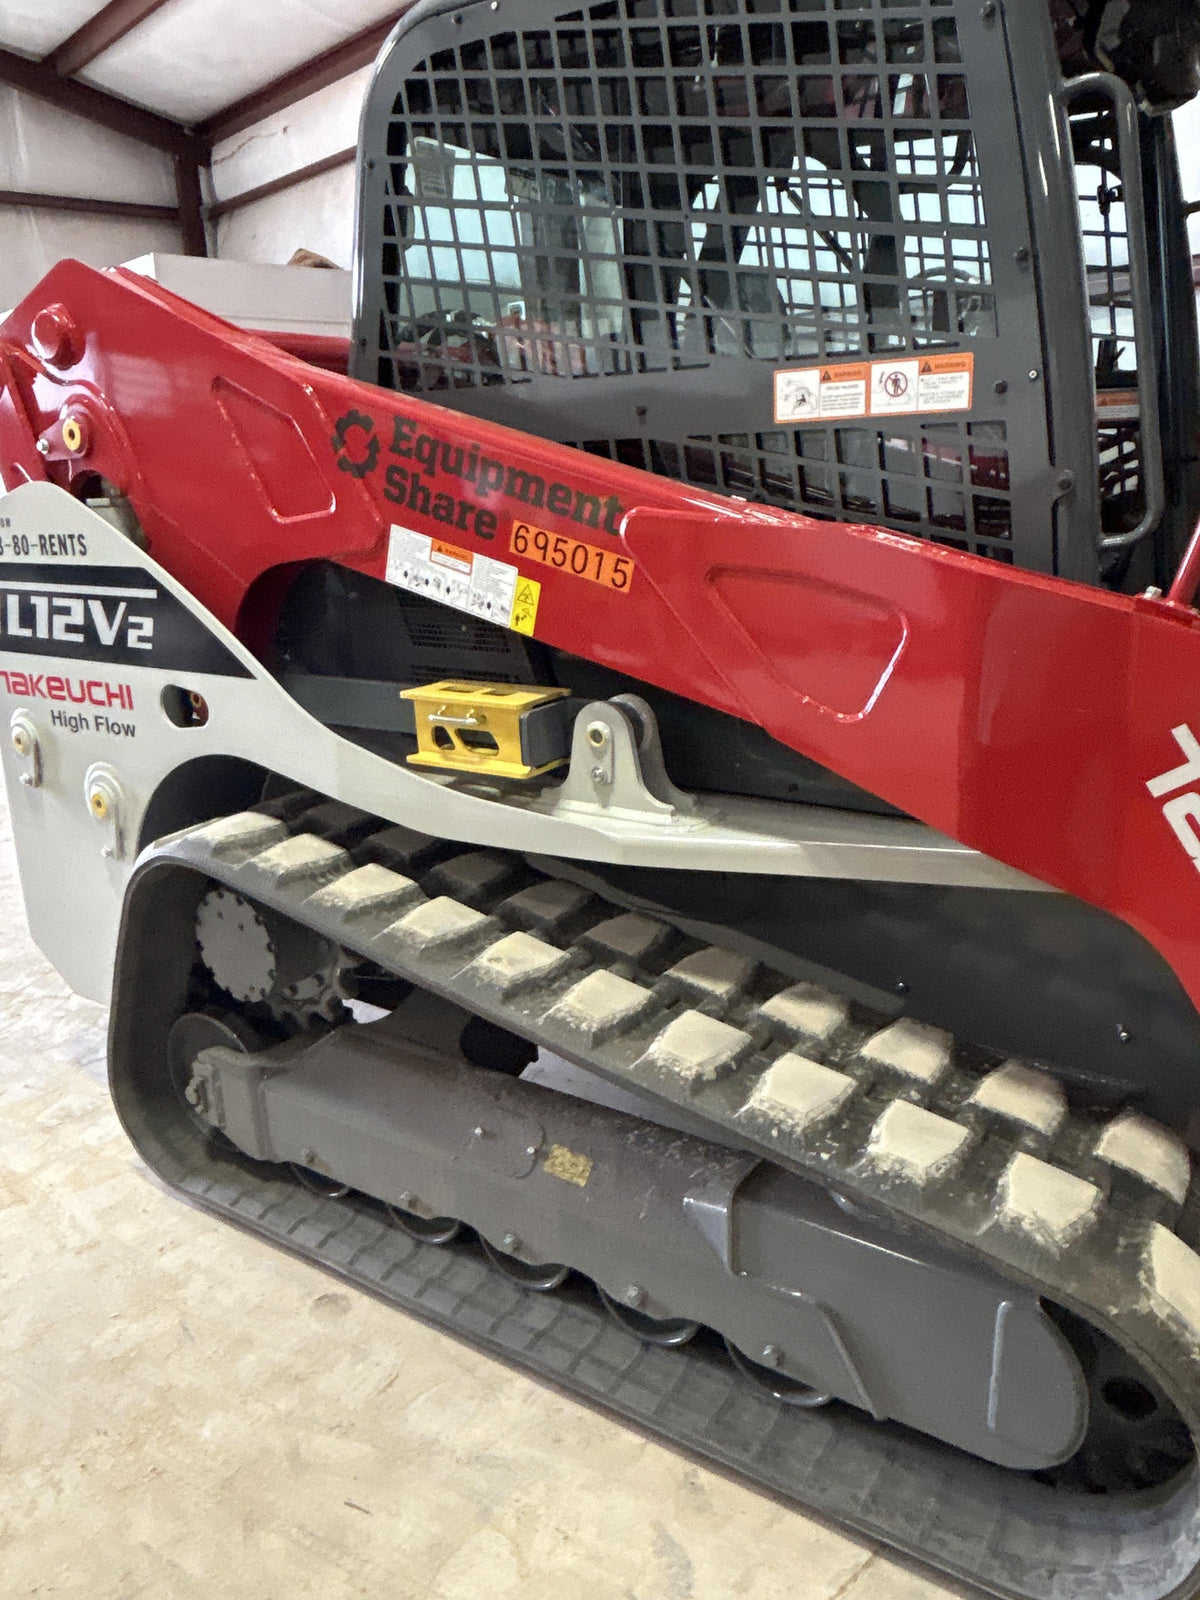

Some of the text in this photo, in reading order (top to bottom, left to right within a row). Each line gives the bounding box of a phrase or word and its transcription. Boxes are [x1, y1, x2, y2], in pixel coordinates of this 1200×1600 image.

[383, 463, 498, 541] Share
[389, 414, 625, 537] Equipment
[513, 523, 630, 589] 695015
[0, 593, 154, 650] L12V2
[50, 709, 136, 738] High Flow
